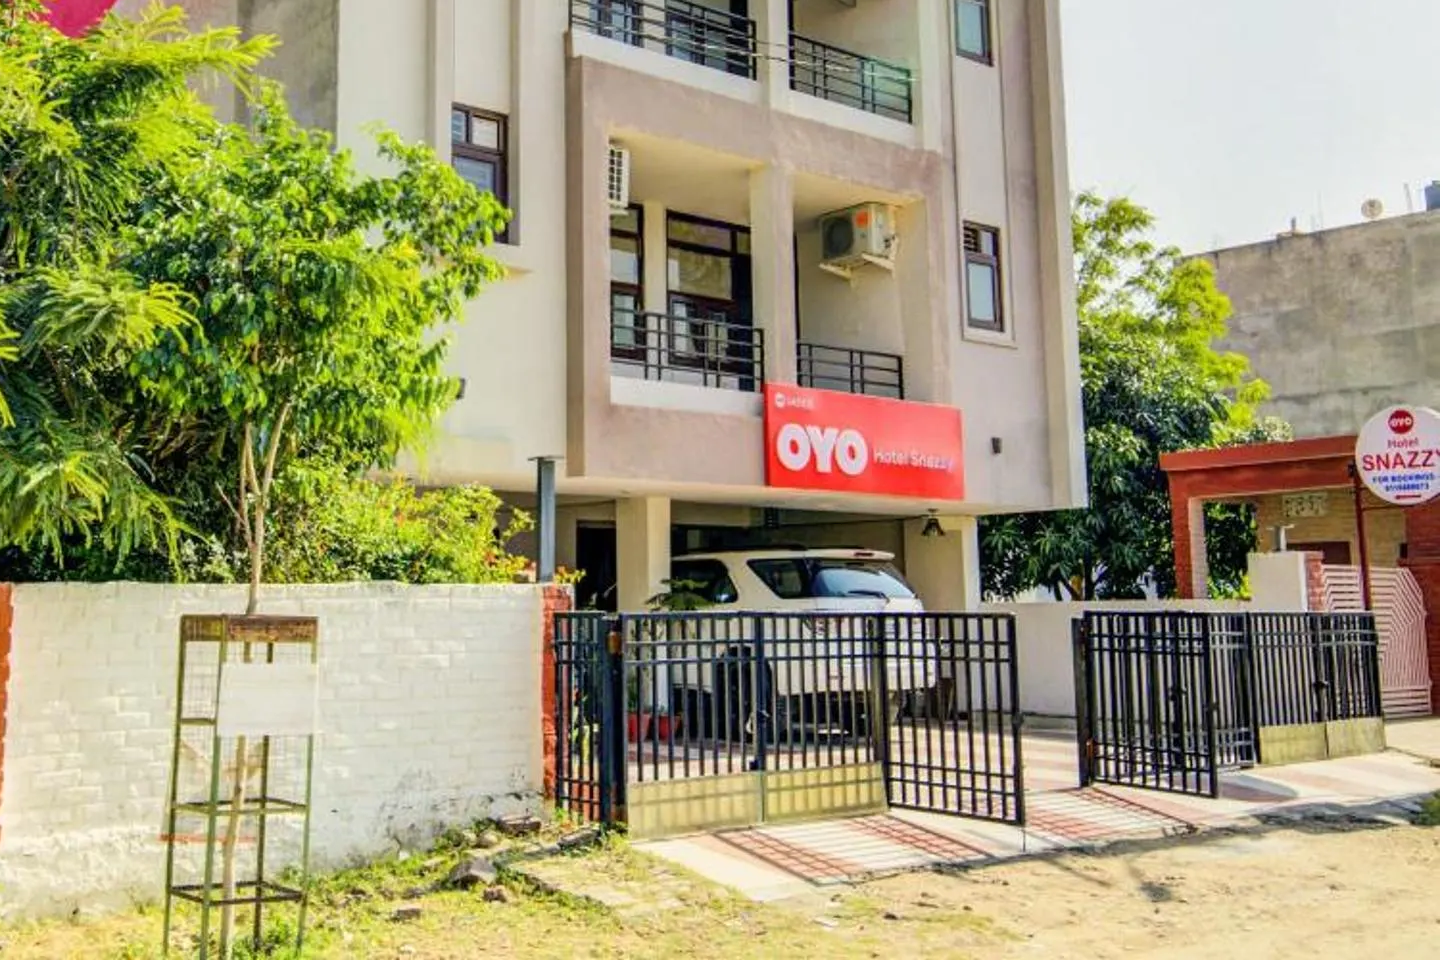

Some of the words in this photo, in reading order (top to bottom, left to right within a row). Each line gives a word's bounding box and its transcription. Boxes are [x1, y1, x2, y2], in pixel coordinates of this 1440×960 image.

[776, 423, 868, 476] OYO
[873, 447, 908, 465] Hotel
[1388, 437, 1418, 448] Hotel
